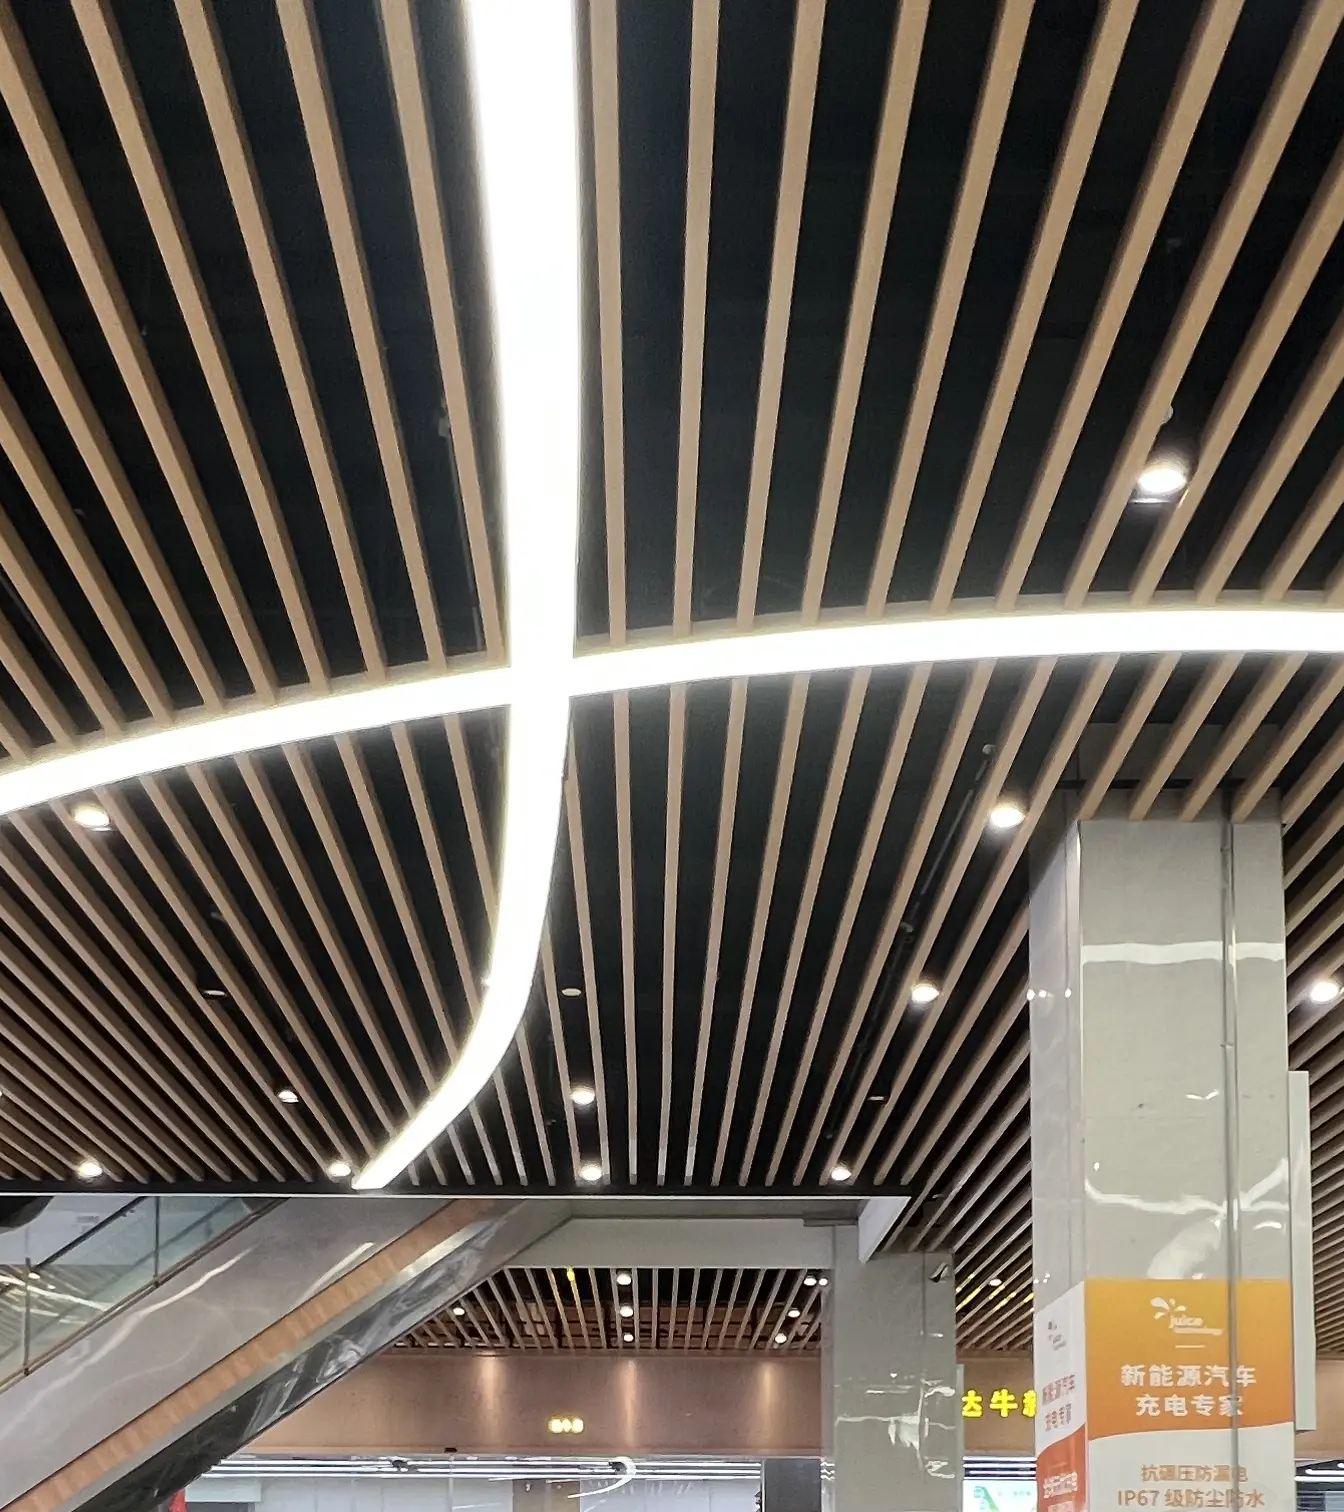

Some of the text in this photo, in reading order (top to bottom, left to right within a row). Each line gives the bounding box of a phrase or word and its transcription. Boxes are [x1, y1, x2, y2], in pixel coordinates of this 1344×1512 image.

[1120, 1364, 1257, 1388] 新能源汽车
[1135, 1394, 1244, 1417] 充电专家
[1118, 1489, 1265, 1508] IP67 级防尘防水
